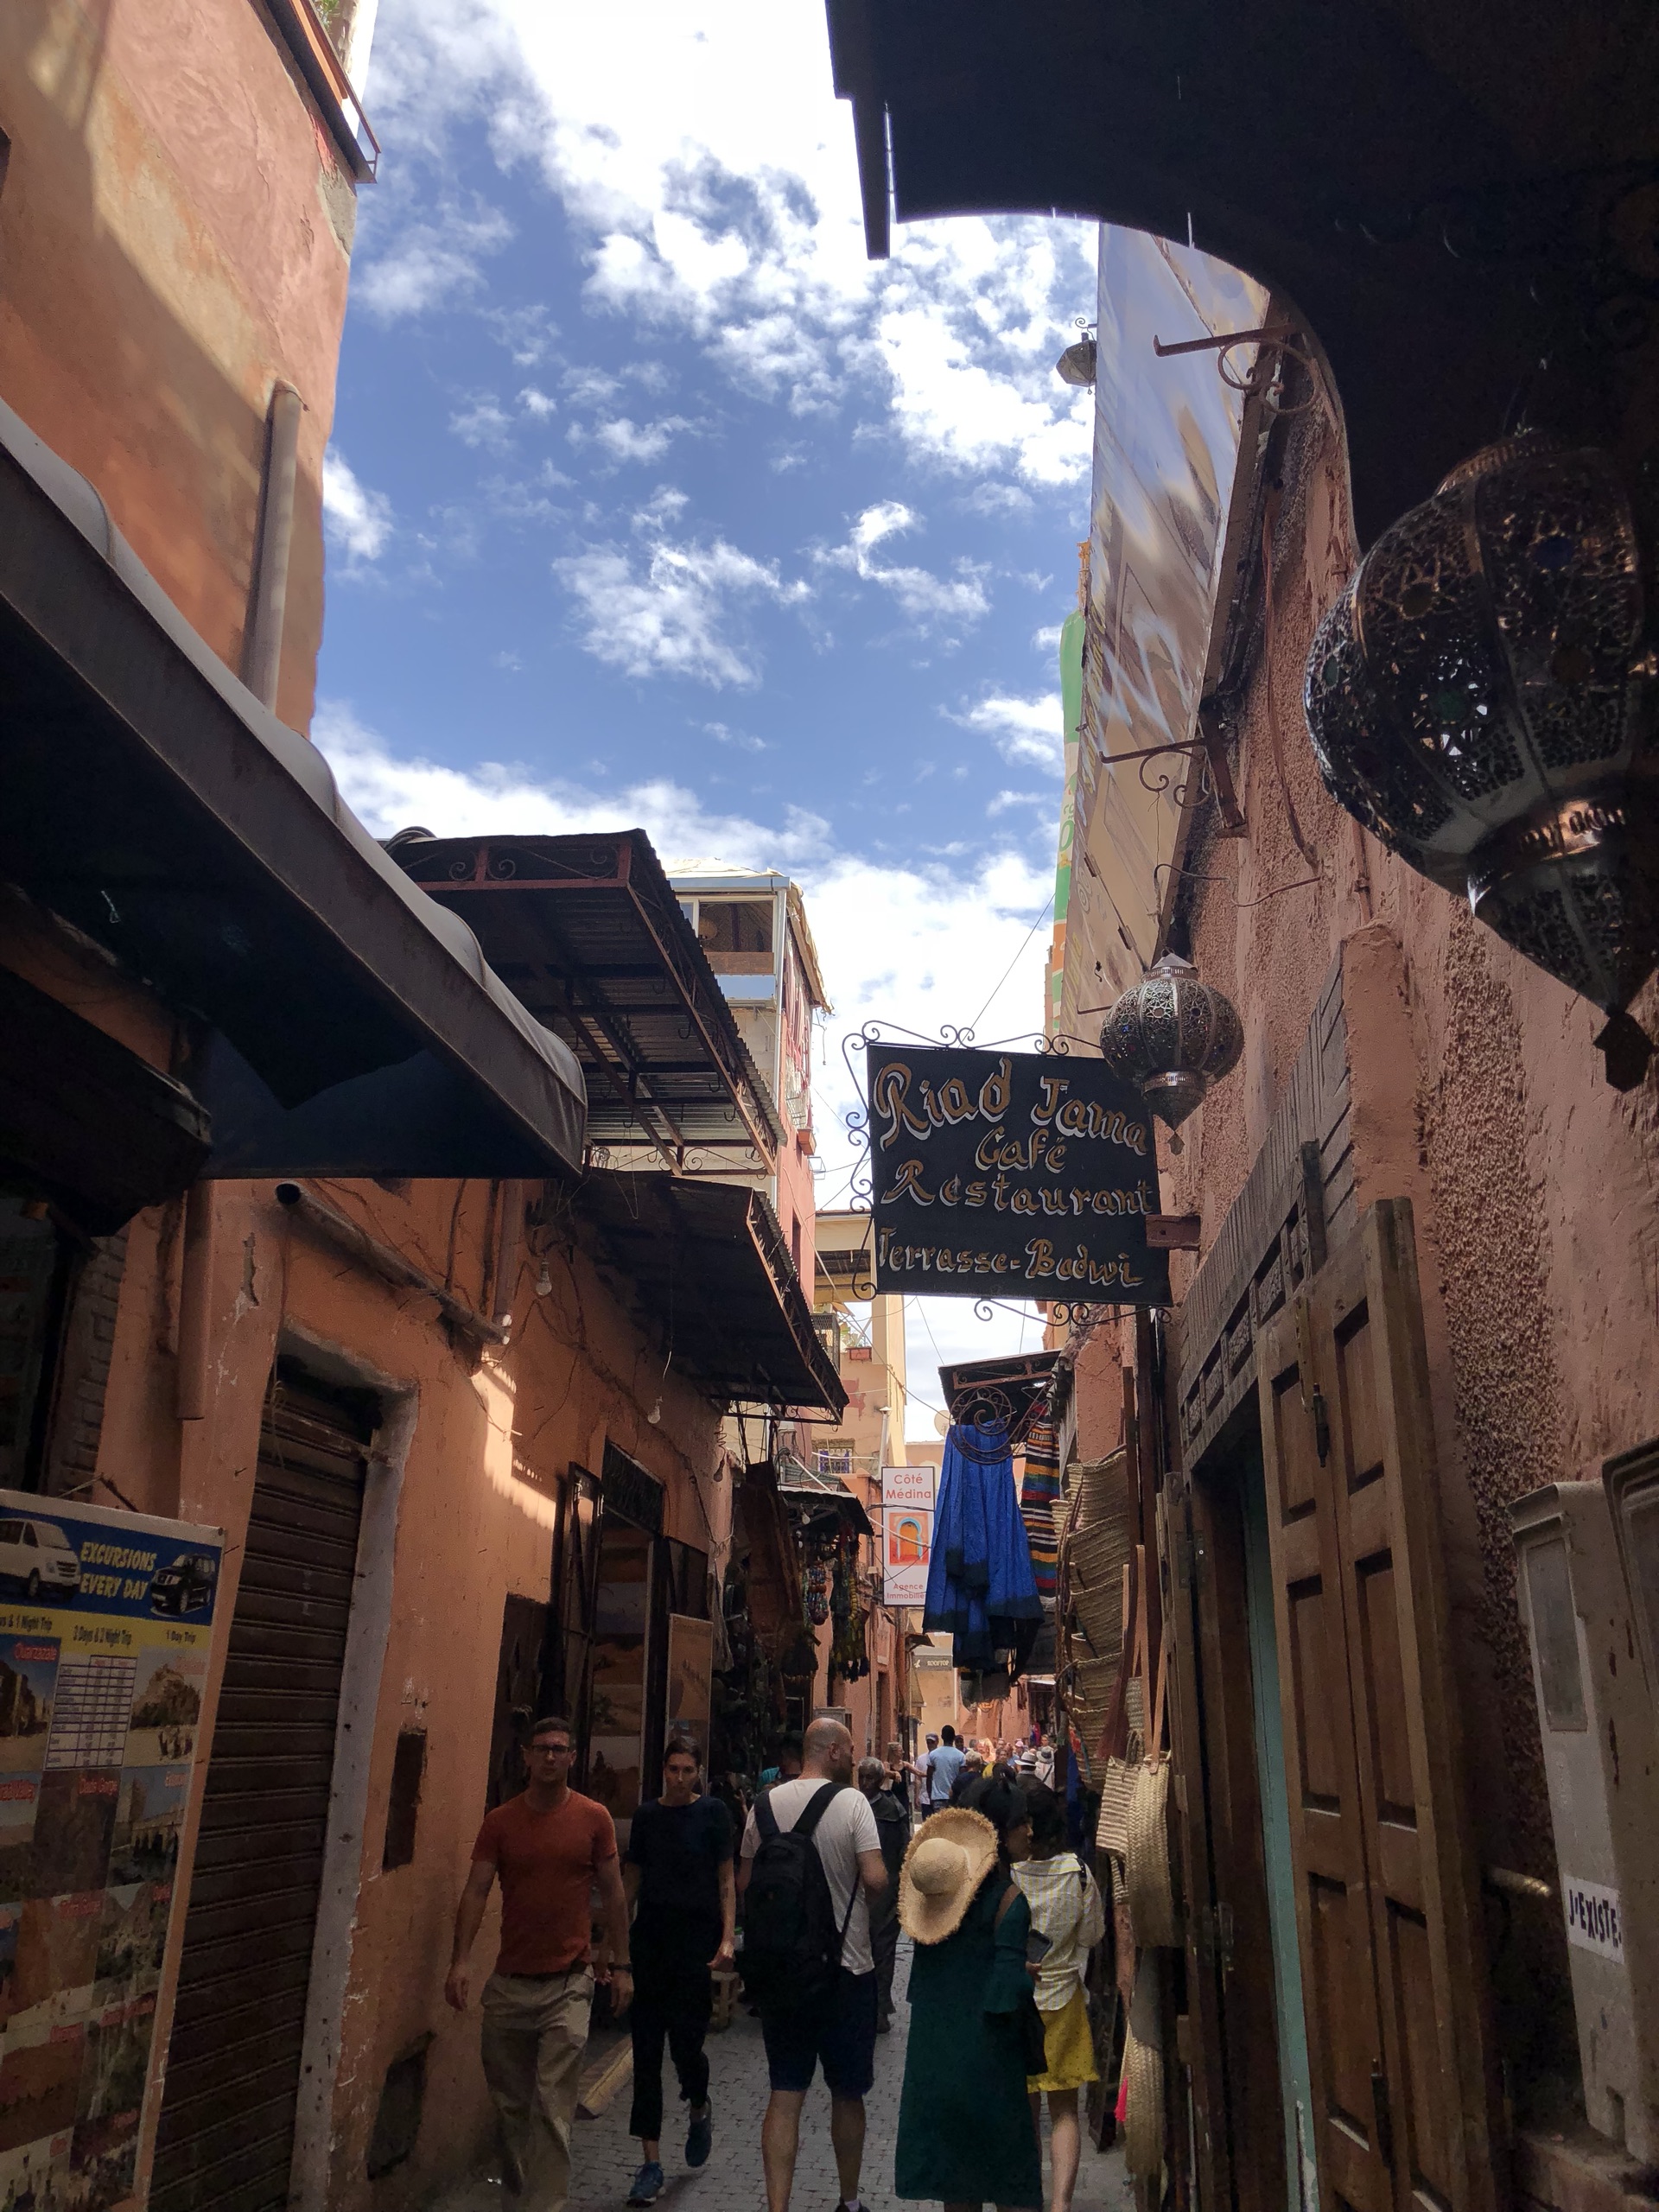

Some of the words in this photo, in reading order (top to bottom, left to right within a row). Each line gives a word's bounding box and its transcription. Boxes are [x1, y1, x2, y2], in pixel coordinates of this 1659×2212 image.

[874, 1057, 1012, 1151] Riad
[1031, 1076, 1147, 1156] Jama
[976, 1126, 1067, 1173] Café
[880, 1160, 1153, 1216] Restaurant
[886, 1487, 931, 1499] Médina
[893, 1472, 923, 1484] Côté
[80, 1541, 157, 1572] EXCURSIONS
[79, 1573, 122, 1598] EVERY
[123, 1579, 149, 1600] DAY
